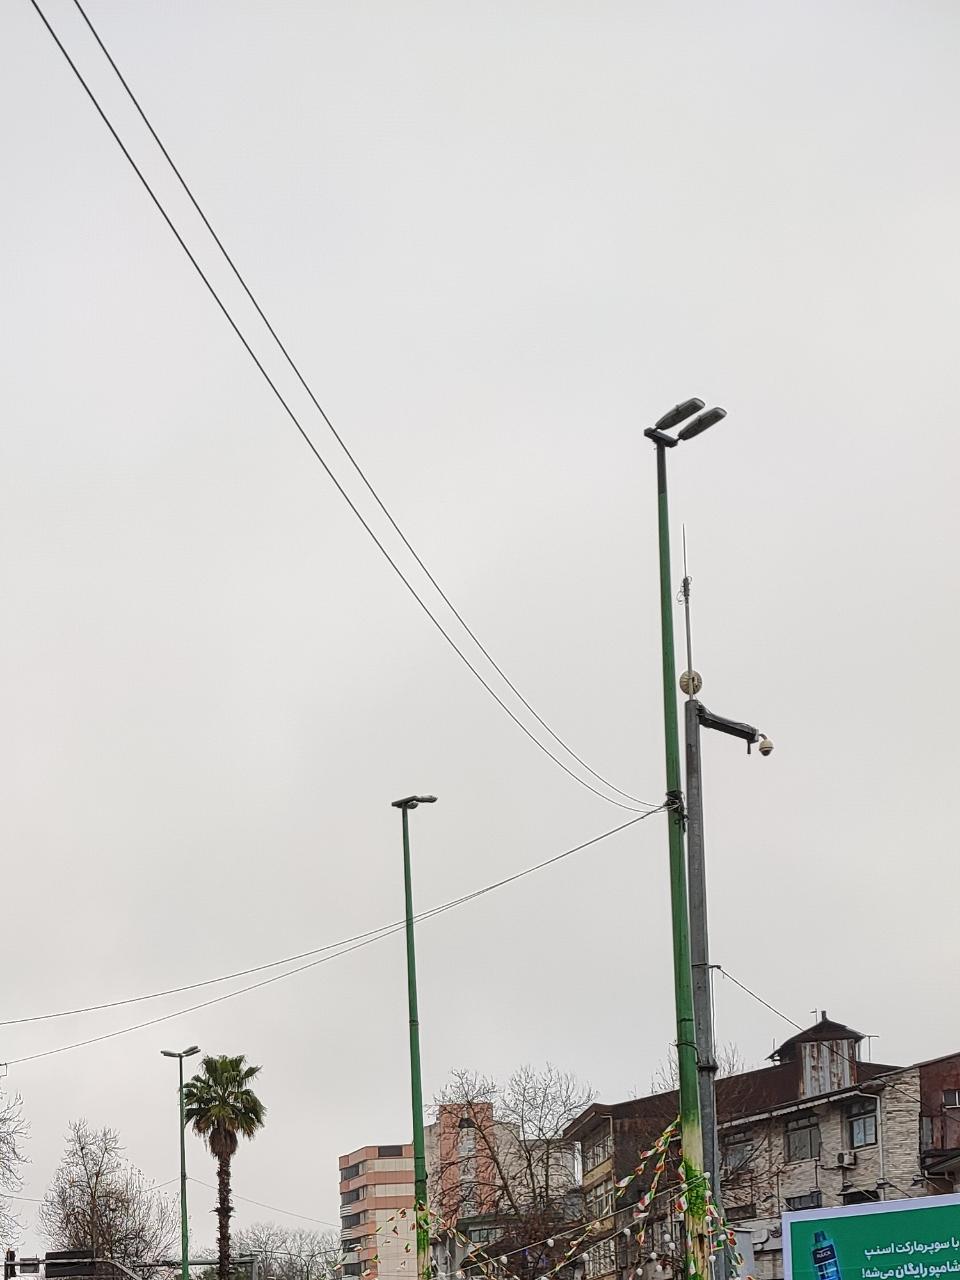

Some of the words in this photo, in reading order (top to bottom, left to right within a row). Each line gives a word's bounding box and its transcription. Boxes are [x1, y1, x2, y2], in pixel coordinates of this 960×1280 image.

[864, 1242, 895, 1261] اسنپ
[895, 1240, 950, 1255] سوپرمارکت
[951, 1236, 960, 1251] با
[895, 1262, 928, 1279] رایگان
[928, 1259, 960, 1278] شامپو
